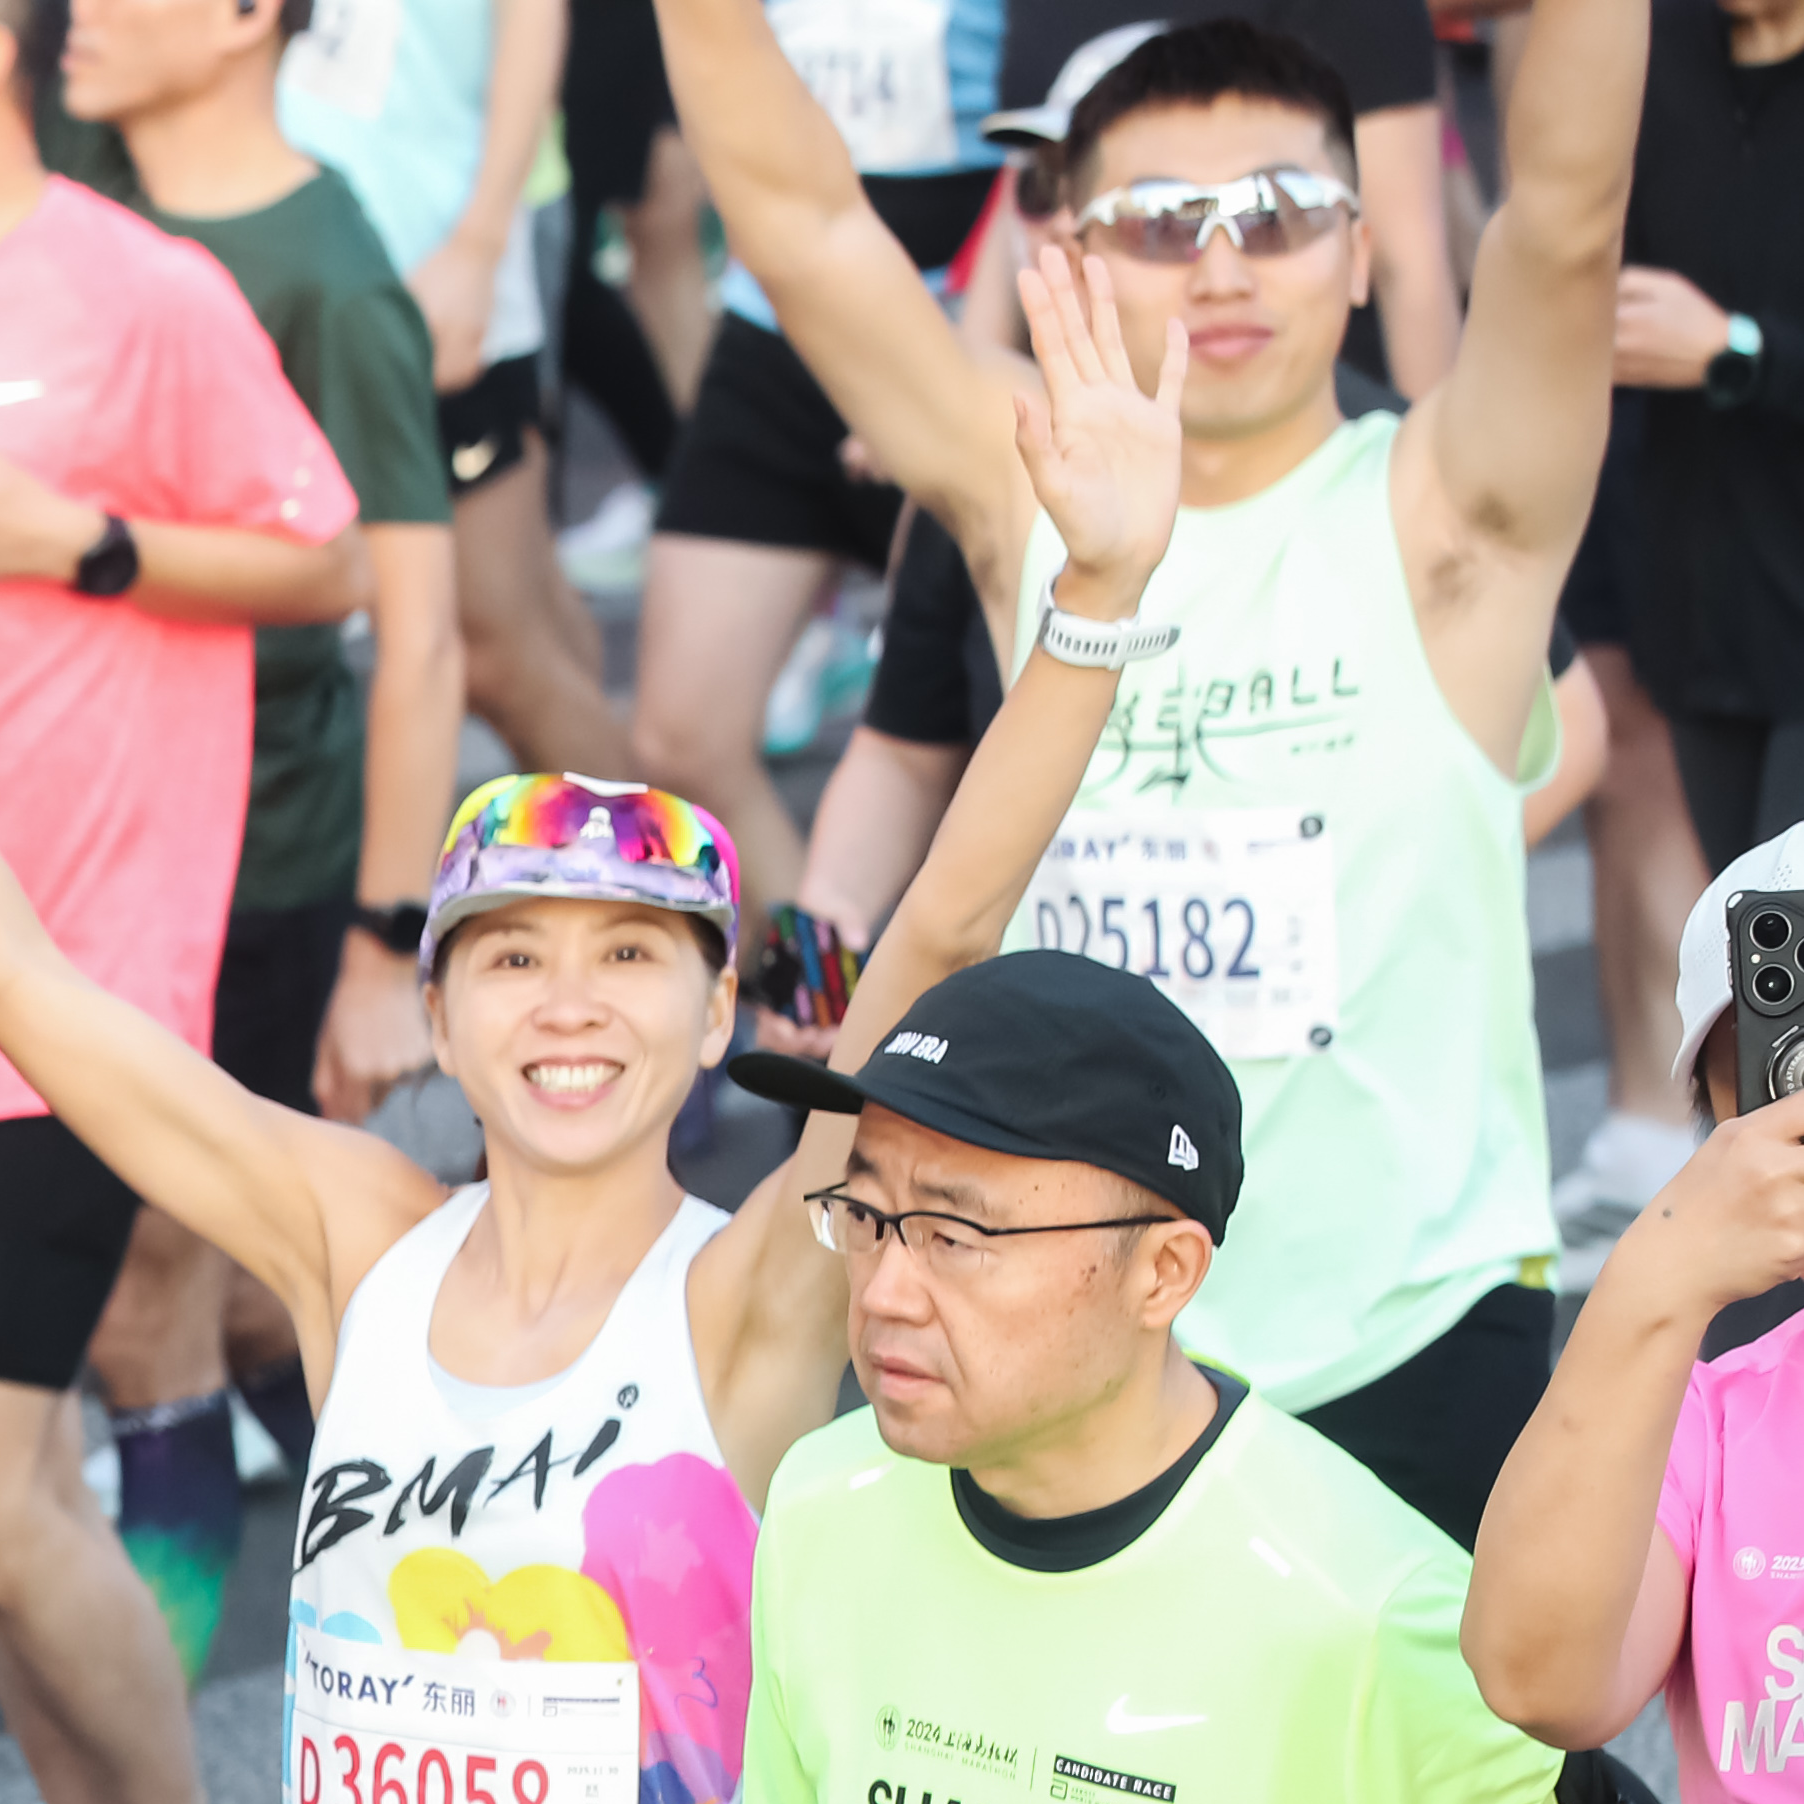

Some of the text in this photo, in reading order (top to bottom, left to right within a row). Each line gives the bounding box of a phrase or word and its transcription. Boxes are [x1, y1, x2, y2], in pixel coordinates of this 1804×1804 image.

[919, 1035, 949, 1064] ERA
[306, 1653, 476, 1718] TORAY 东丽
[906, 1718, 941, 1743] 2024
[1055, 1758, 1172, 1801] CANDIDATE RACE
